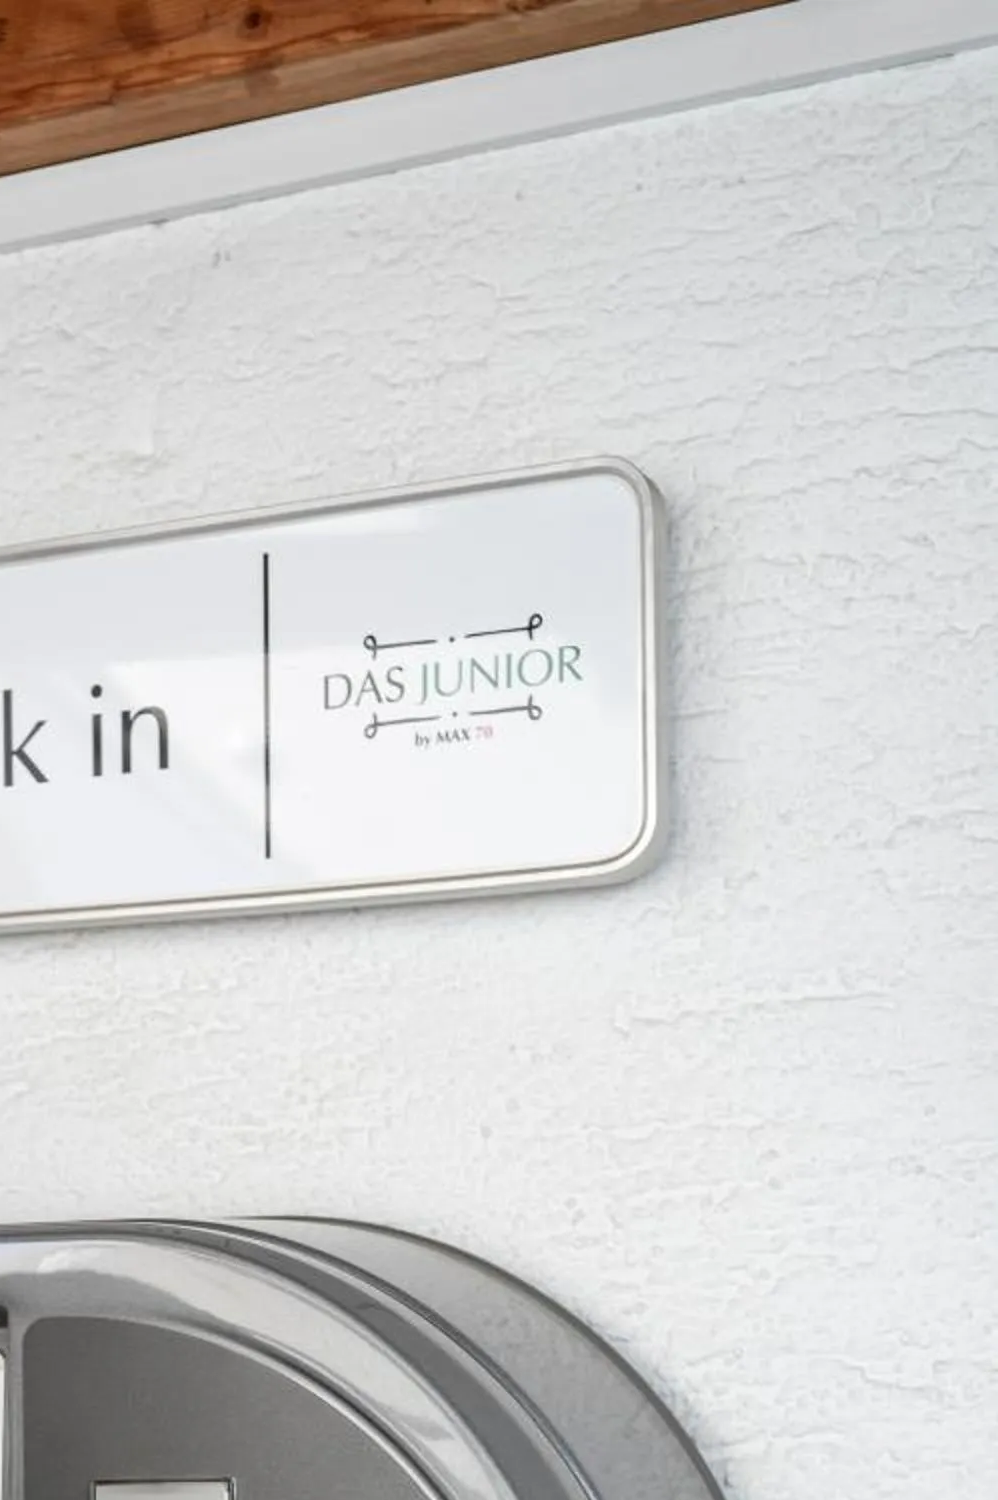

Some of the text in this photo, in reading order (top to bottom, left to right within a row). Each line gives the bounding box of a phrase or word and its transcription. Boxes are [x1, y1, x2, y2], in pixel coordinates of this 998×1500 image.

[323, 645, 583, 710] DAS JUNIOR
[90, 684, 169, 777] in
[414, 731, 430, 750] by
[435, 727, 471, 744] MAX
